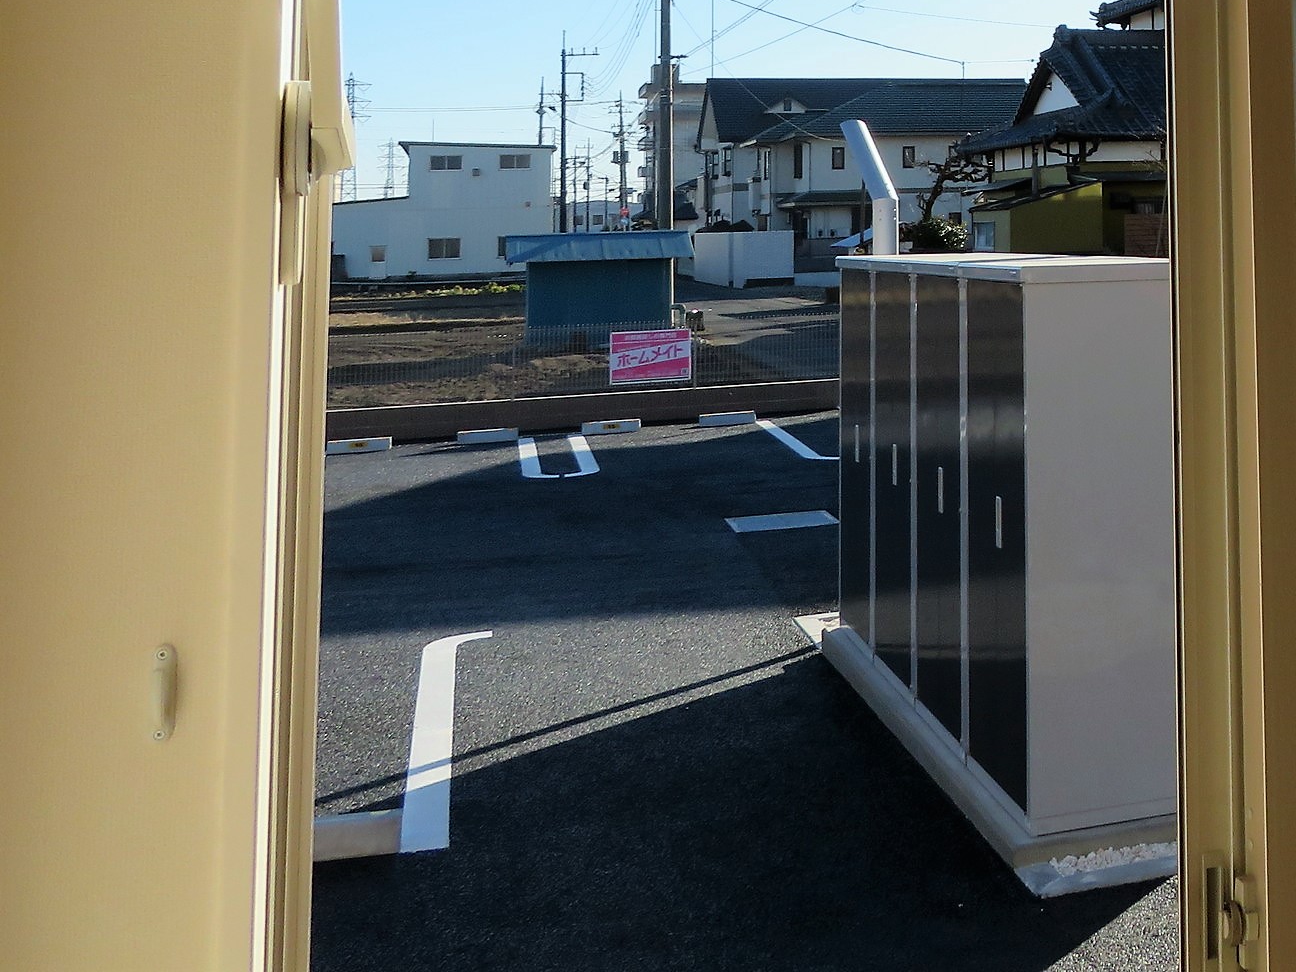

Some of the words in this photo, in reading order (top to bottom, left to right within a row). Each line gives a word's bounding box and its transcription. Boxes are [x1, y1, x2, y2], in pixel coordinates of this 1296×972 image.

[616, 343, 684, 368] ホームメイト
